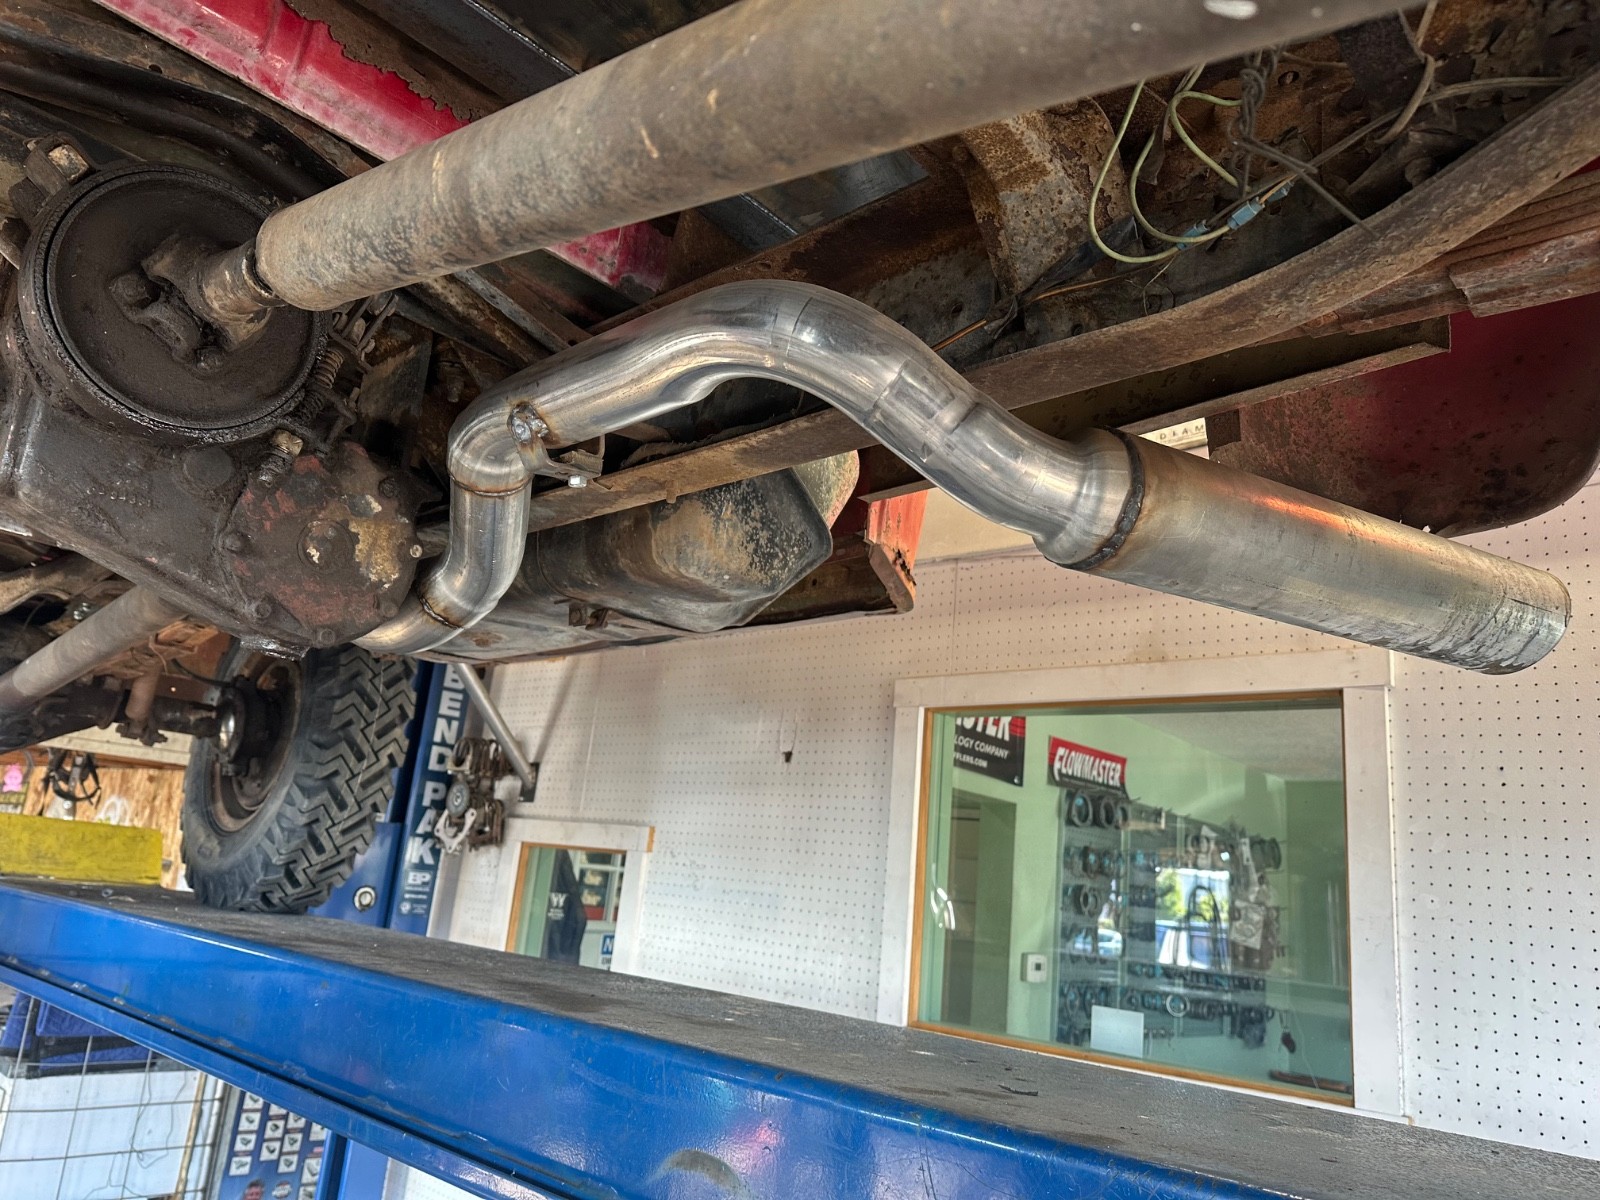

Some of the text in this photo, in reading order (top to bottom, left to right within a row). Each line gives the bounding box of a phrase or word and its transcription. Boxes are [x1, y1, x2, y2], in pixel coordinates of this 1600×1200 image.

[974, 740, 1010, 759] COMPANY
[1053, 746, 1122, 788] FLOWMASTER
[408, 872, 432, 885] BP
